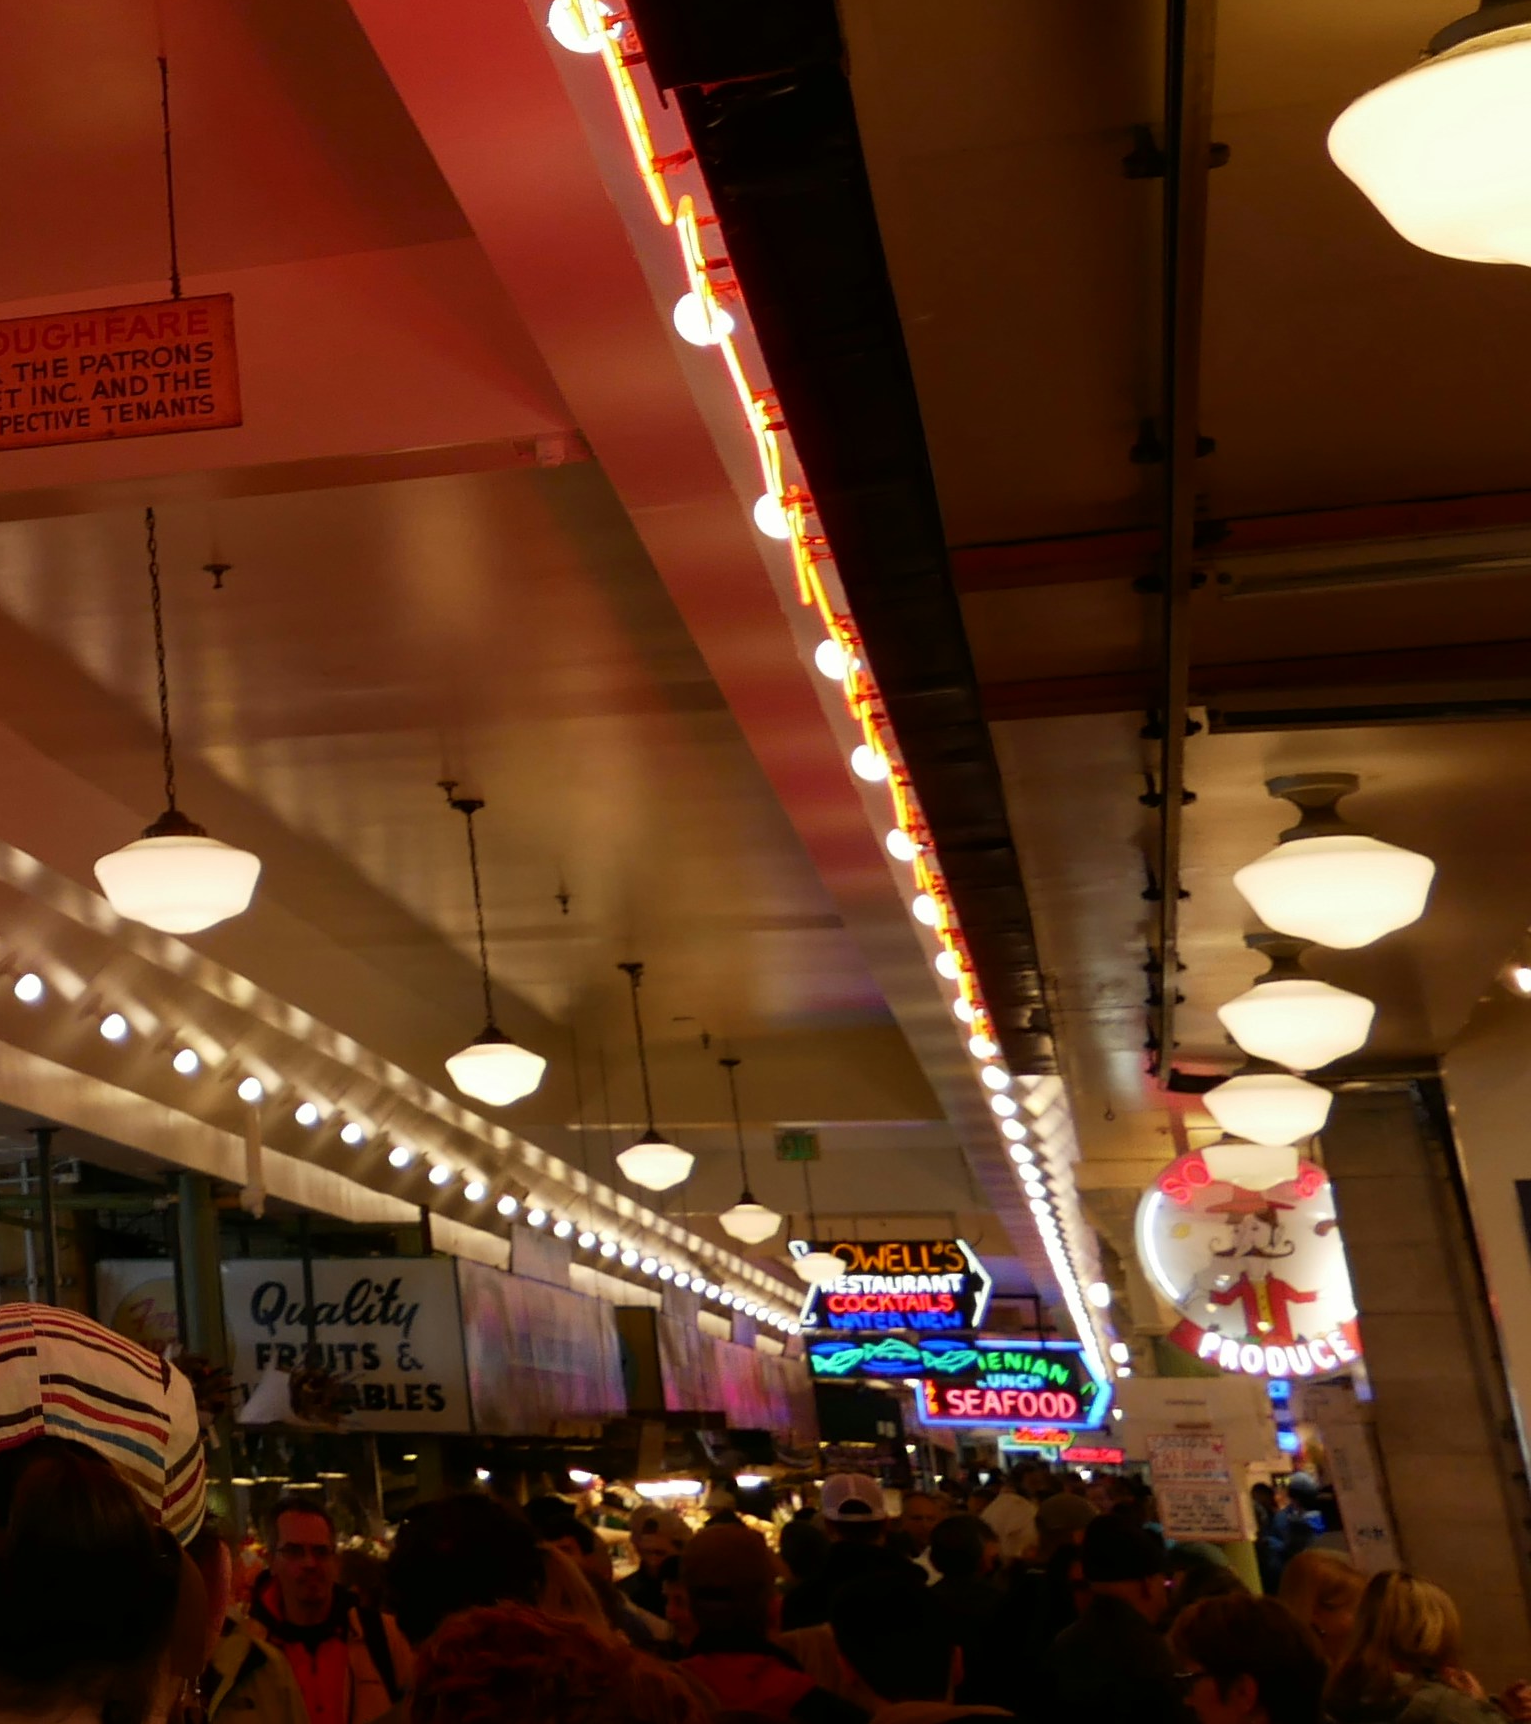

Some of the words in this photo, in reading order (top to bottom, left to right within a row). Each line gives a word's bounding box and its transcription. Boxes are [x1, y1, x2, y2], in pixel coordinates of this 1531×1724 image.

[12, 357, 69, 382] THE
[79, 341, 214, 376] PATRONS
[31, 382, 83, 406] INC.
[91, 375, 149, 400] AND
[153, 368, 212, 393] THE
[101, 394, 215, 424] TENANTS
[830, 1242, 965, 1273] OWELL'S
[250, 1277, 421, 1338] Quality
[827, 1293, 955, 1313] COCKTAILS
[828, 1312, 904, 1330] WATER
[906, 1312, 964, 1330] VIEW
[396, 1342, 425, 1372] &
[1197, 1331, 1358, 1377] PRODUCE
[945, 1388, 1078, 1419] SEAFOOD
